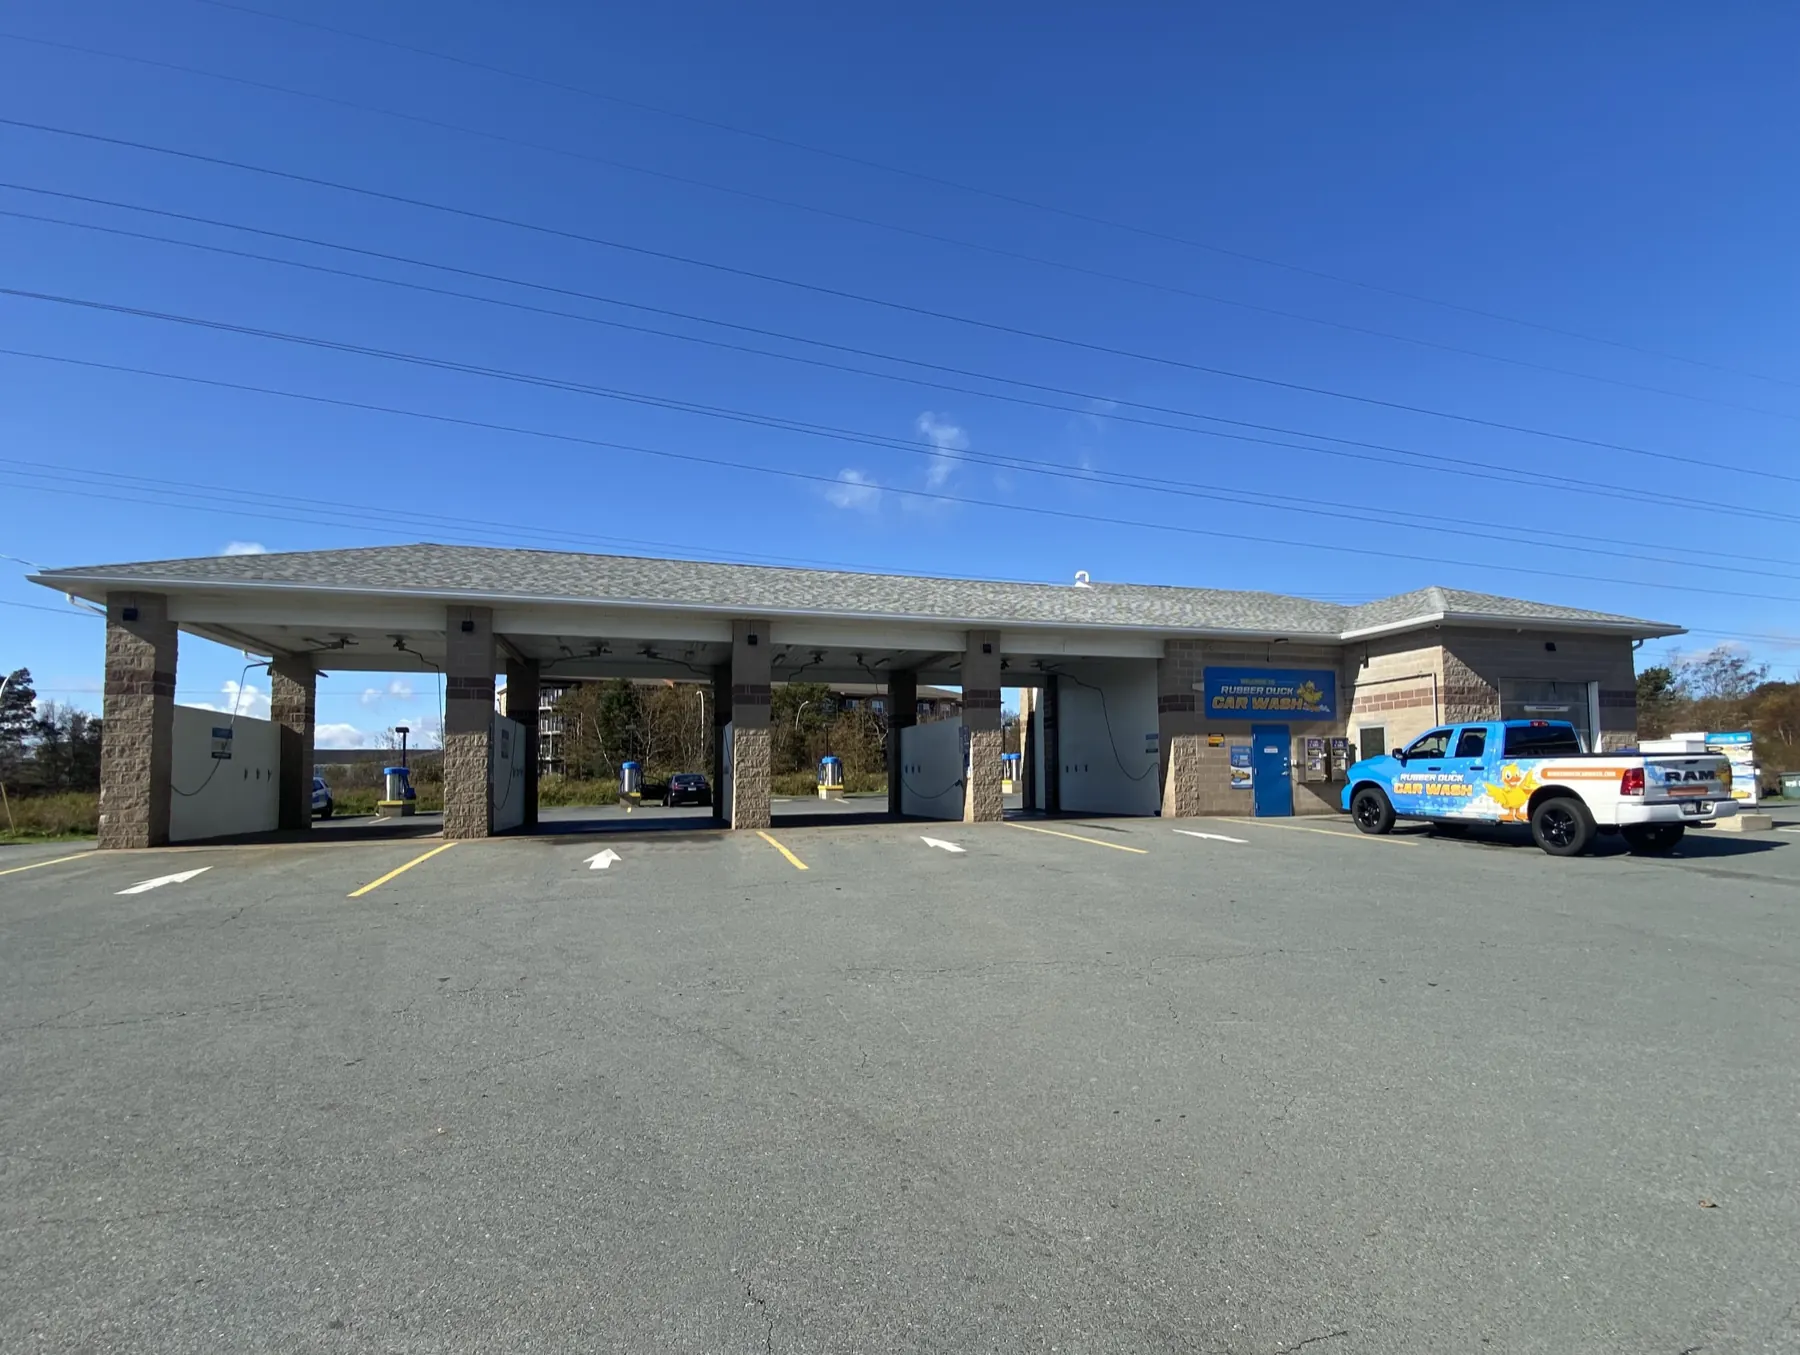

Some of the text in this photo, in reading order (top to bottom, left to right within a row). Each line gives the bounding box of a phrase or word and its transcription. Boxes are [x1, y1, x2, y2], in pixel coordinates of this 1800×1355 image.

[1221, 686, 1294, 696] RUBBER DUCK
[1212, 696, 1303, 710] CAR WASH
[1665, 770, 1715, 782] RAM
[1394, 783, 1473, 796] CAR WASH
